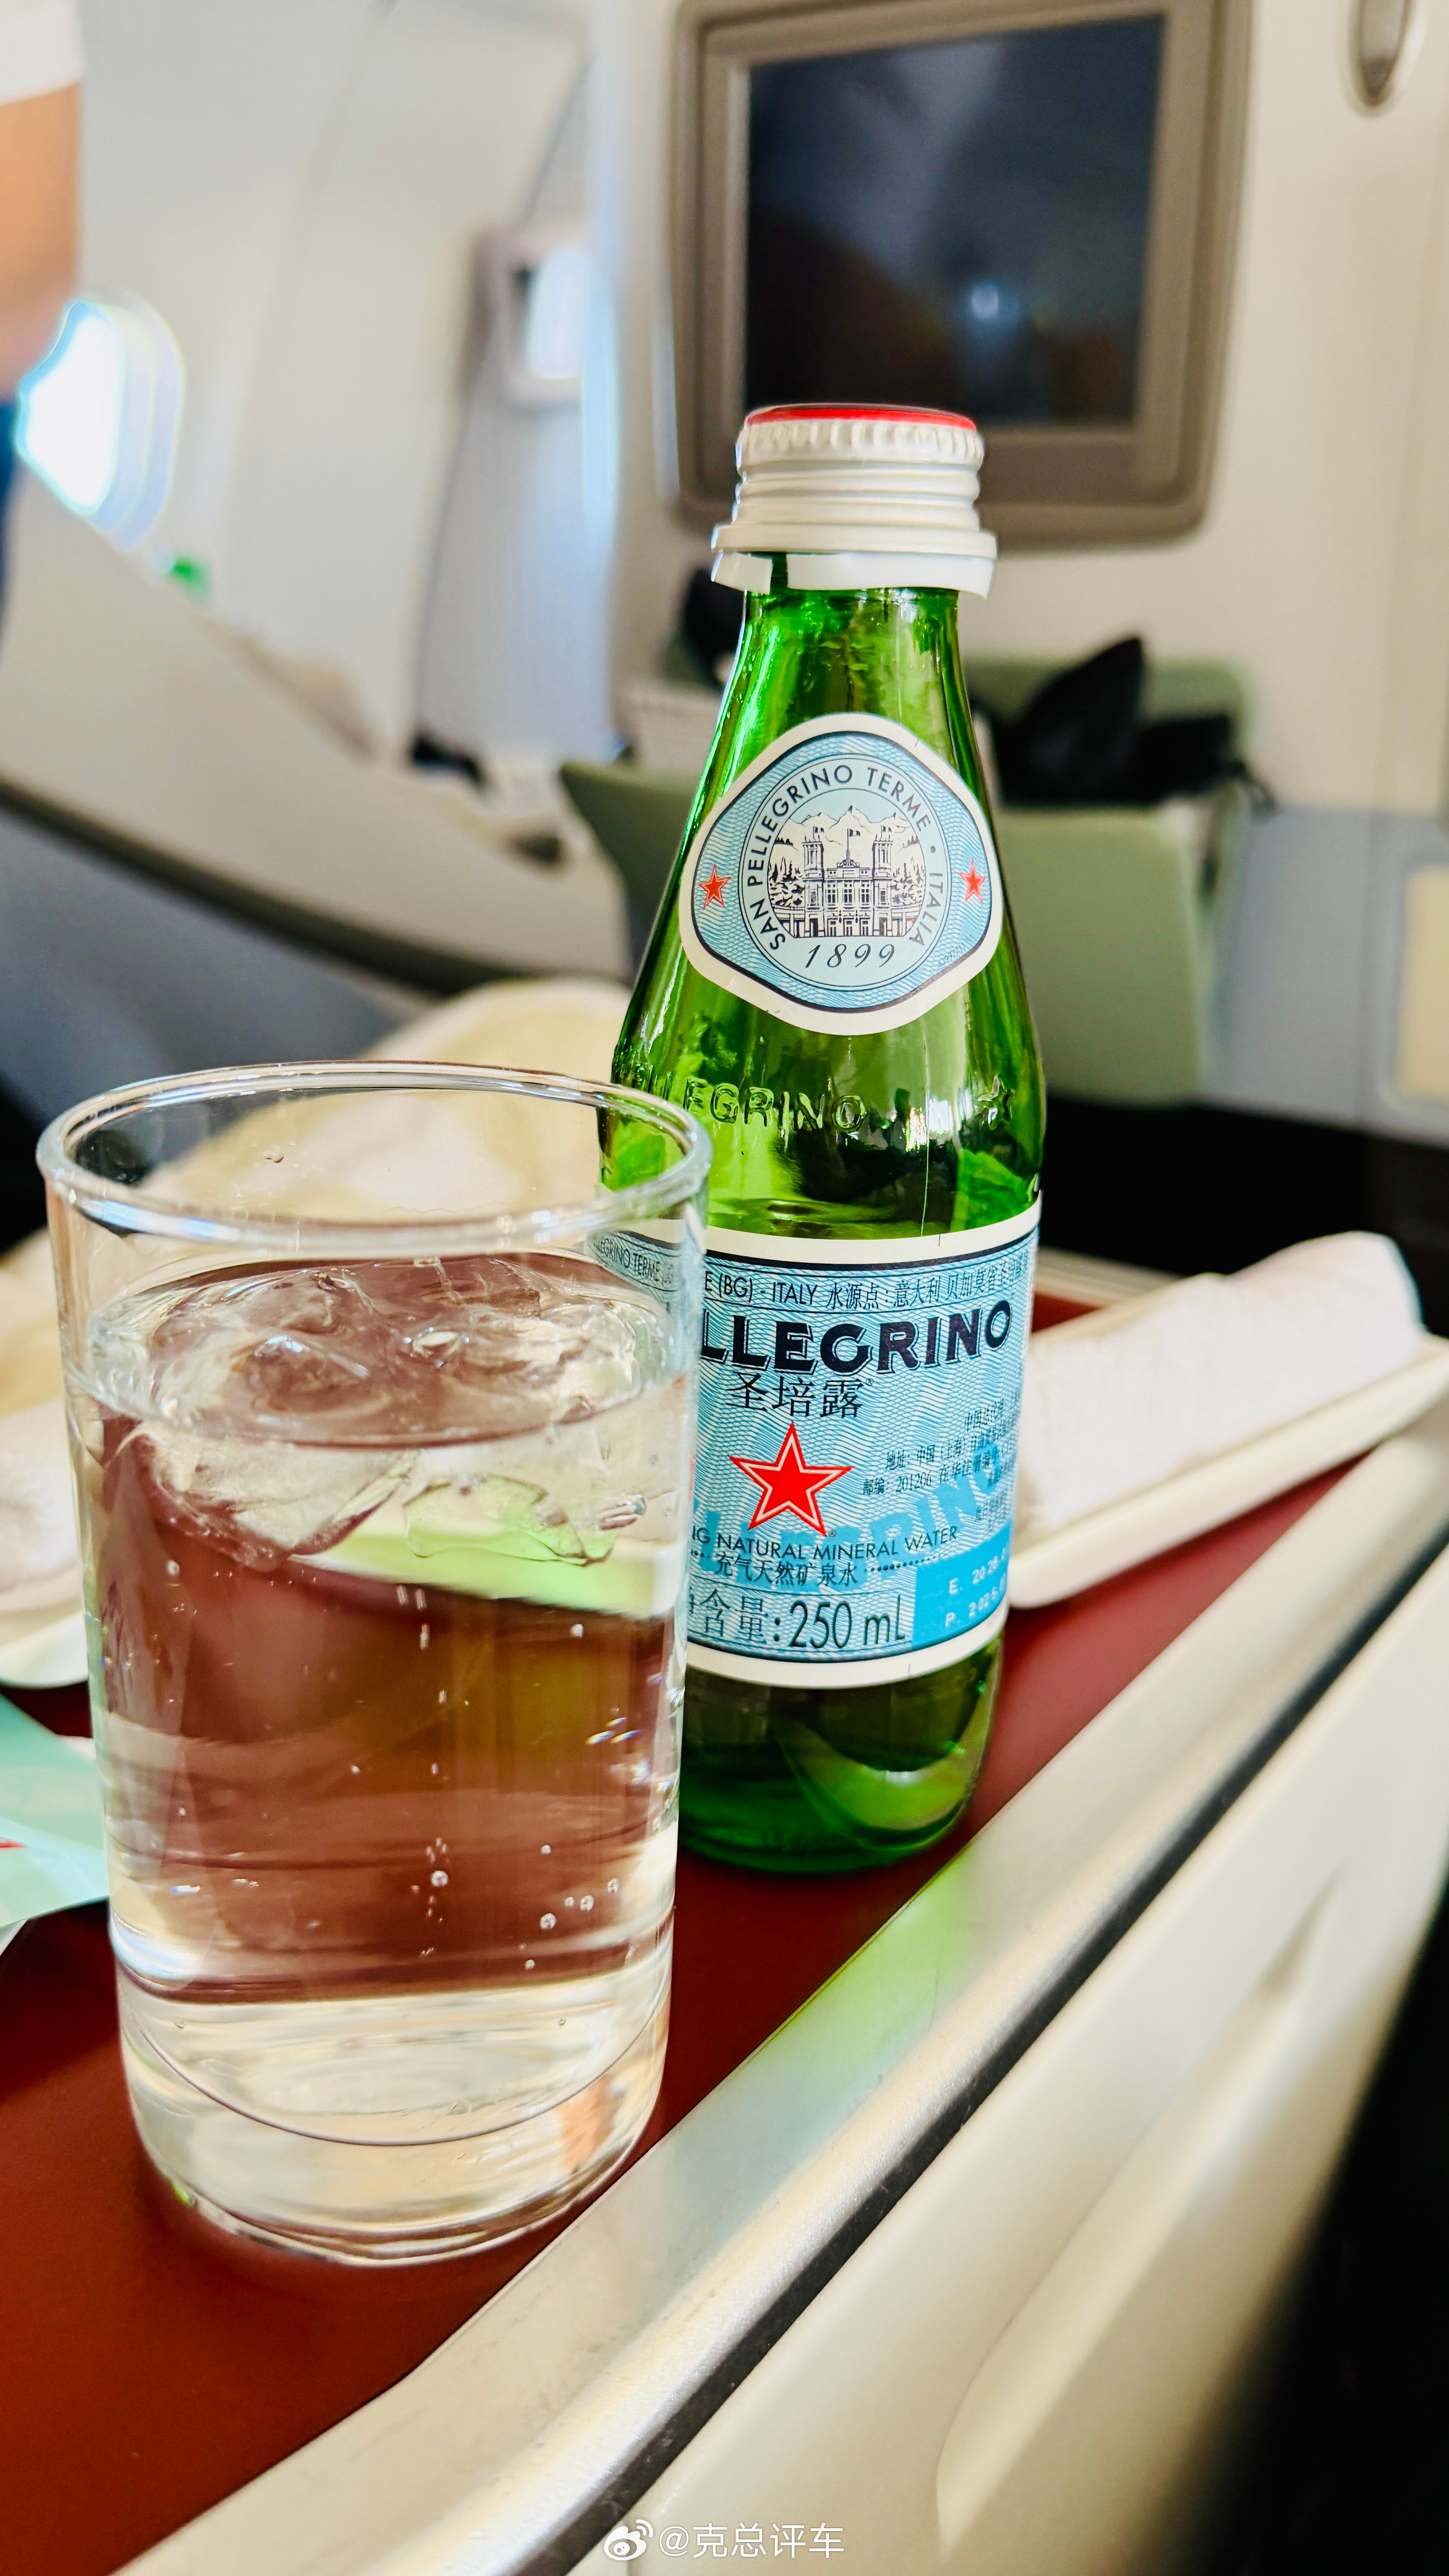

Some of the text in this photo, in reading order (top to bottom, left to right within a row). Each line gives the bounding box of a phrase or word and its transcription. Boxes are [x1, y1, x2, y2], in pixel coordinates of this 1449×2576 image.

[748, 765, 943, 950] SAN PELLEGRINO TERME ITALIA
[805, 943, 896, 968] 1899
[719, 1272, 753, 1303] (BG)
[772, 1282, 817, 1305] ITALY
[895, 1470, 932, 1492] 201206
[717, 1532, 806, 1559] NATURAL
[813, 1539, 899, 1560] MINERAL
[904, 1526, 957, 1553] WATER
[714, 1551, 858, 1587] 充气天然矿泉水
[864, 1594, 906, 1646] mL
